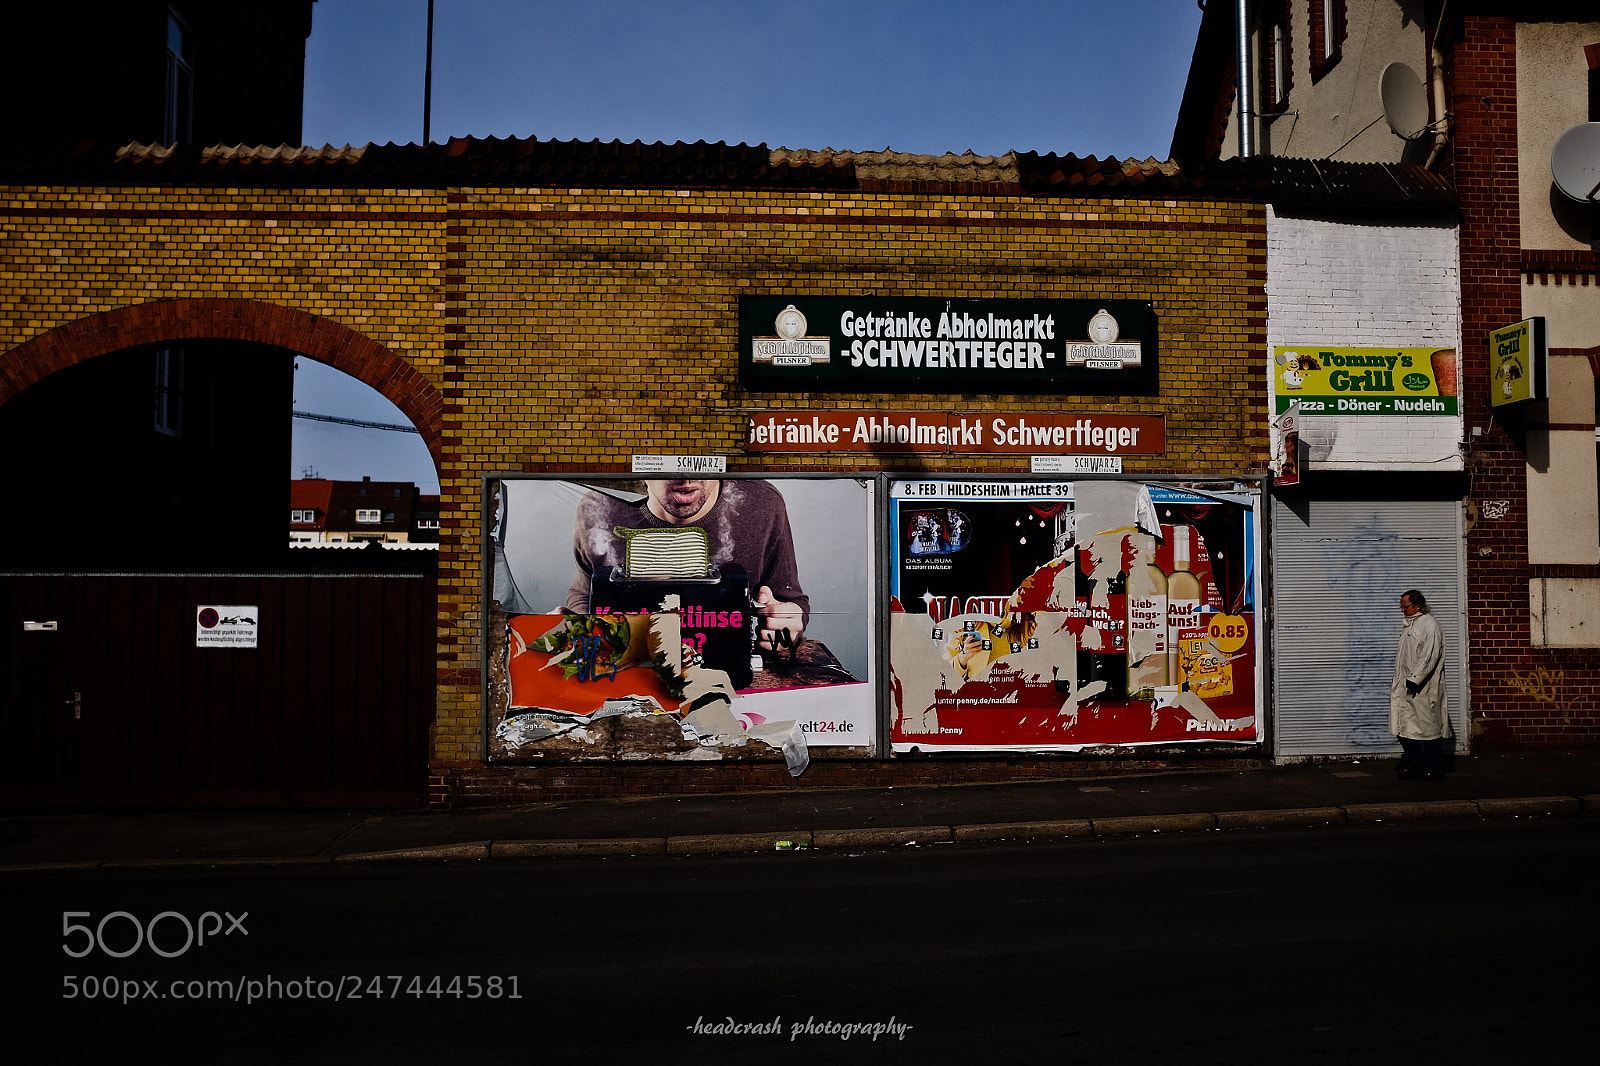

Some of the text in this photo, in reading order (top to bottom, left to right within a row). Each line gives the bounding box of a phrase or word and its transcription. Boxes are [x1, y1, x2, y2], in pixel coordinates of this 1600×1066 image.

[840, 310, 1055, 340] Getränke Abholmarkt
[1497, 339, 1520, 357] Grill
[776, 356, 807, 365] PILSNER
[1088, 360, 1120, 369] PILSNER
[1318, 351, 1414, 371] Tommy's
[1328, 369, 1396, 392] Grill
[1289, 398, 1325, 412] Pizza
[1337, 399, 1382, 412] Döner
[1394, 399, 1445, 412] Nudeln
[992, 417, 1140, 452] Schwertfeger
[677, 456, 719, 472] SCHWARZ
[1074, 457, 1115, 473] SCHWARZ
[904, 483, 915, 496] 8.
[918, 483, 937, 496] FEB
[947, 484, 1010, 497] HILDESHEIM
[1020, 485, 1052, 496] HALLE
[1055, 484, 1069, 496] 39
[1131, 598, 1157, 608] Lieb-
[1168, 602, 1193, 616] Auf
[1092, 608, 1111, 621] Ich,
[1131, 609, 1161, 620] lings-
[1168, 615, 1198, 627] uns!
[1131, 620, 1160, 629] nach-
[1210, 624, 1245, 639] 0.85
[940, 726, 963, 736] Penny
